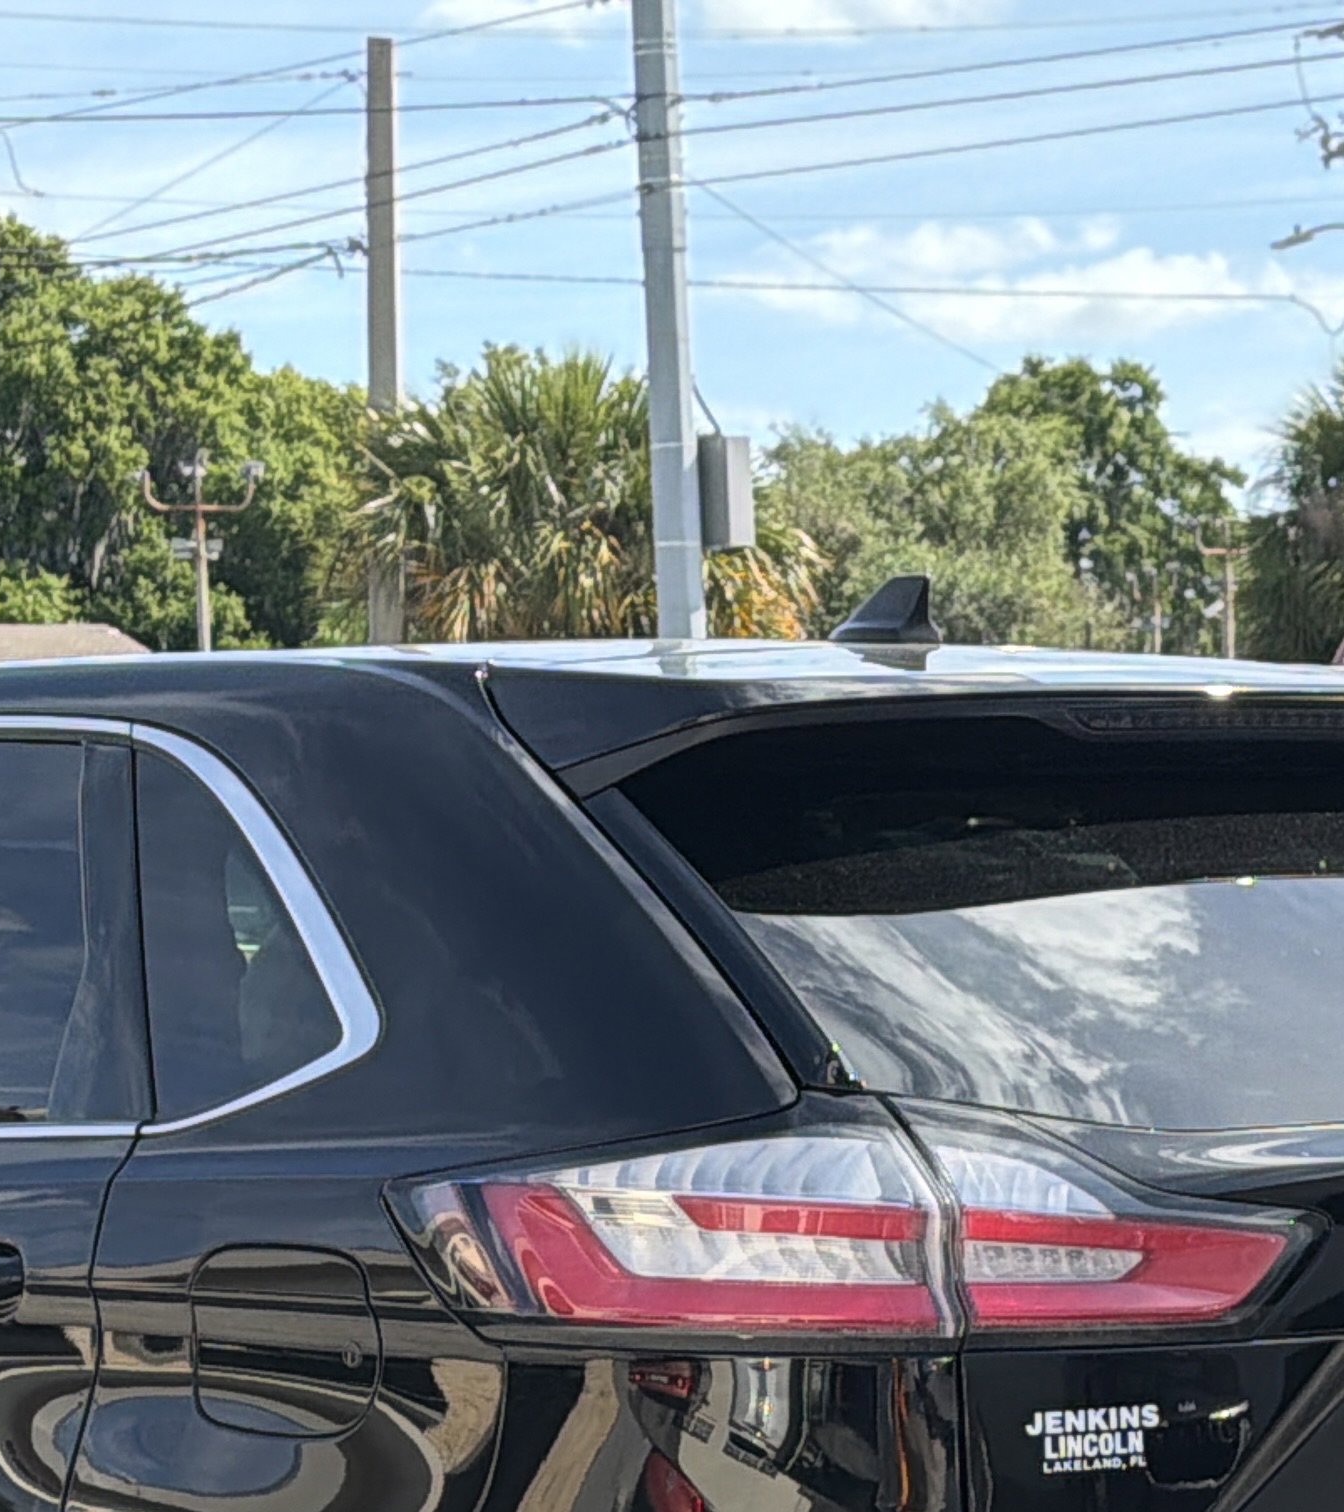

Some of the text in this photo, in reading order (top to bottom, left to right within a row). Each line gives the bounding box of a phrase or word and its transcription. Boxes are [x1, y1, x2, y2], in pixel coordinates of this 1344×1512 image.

[1024, 1403, 1161, 1437] JENKINS
[1043, 1430, 1145, 1460] LINCOLN
[1042, 1456, 1128, 1475] LAKELAND,
